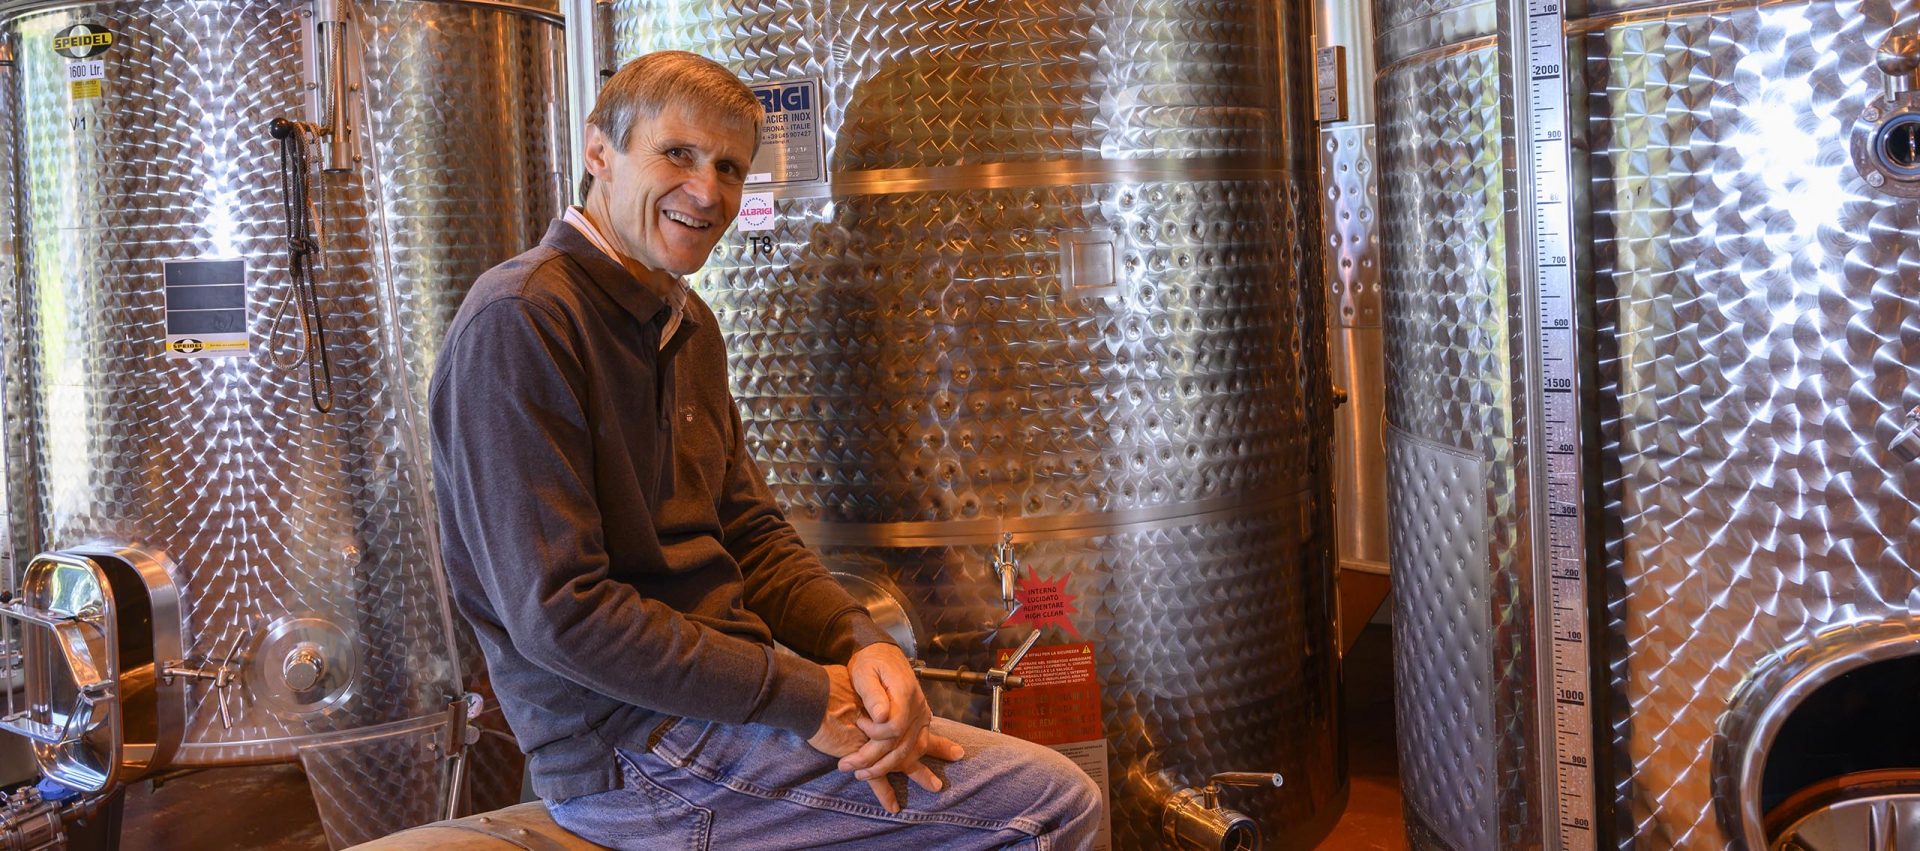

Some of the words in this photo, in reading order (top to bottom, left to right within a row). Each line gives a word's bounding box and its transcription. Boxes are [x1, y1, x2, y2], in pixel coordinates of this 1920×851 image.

[1543, 4, 1557, 12] 100
[54, 34, 109, 49] SPEIDEL
[69, 64, 86, 78] 1600
[90, 64, 102, 76] Ltr.
[1535, 64, 1559, 75] 2000
[753, 86, 810, 113] RIGI
[766, 114, 788, 123] ACIER
[791, 112, 811, 121] INOX
[790, 123, 811, 131] ITALIE
[1547, 130, 1562, 138] 900
[740, 207, 772, 216] ALBRIGI
[749, 235, 773, 254] T8
[1554, 318, 1568, 326] 600
[1547, 378, 1571, 388] 1500
[1562, 506, 1576, 514] 300
[1565, 569, 1579, 577] 200
[1028, 587, 1057, 596] INTERNO
[1023, 602, 1064, 612] ALIMENTARE
[1025, 612, 1041, 620] HIGH
[1042, 610, 1064, 618] CLEAN
[1568, 631, 1582, 639] 100
[1560, 689, 1584, 700] 1000
[1572, 755, 1587, 764] 900
[1574, 817, 1589, 827] 800
